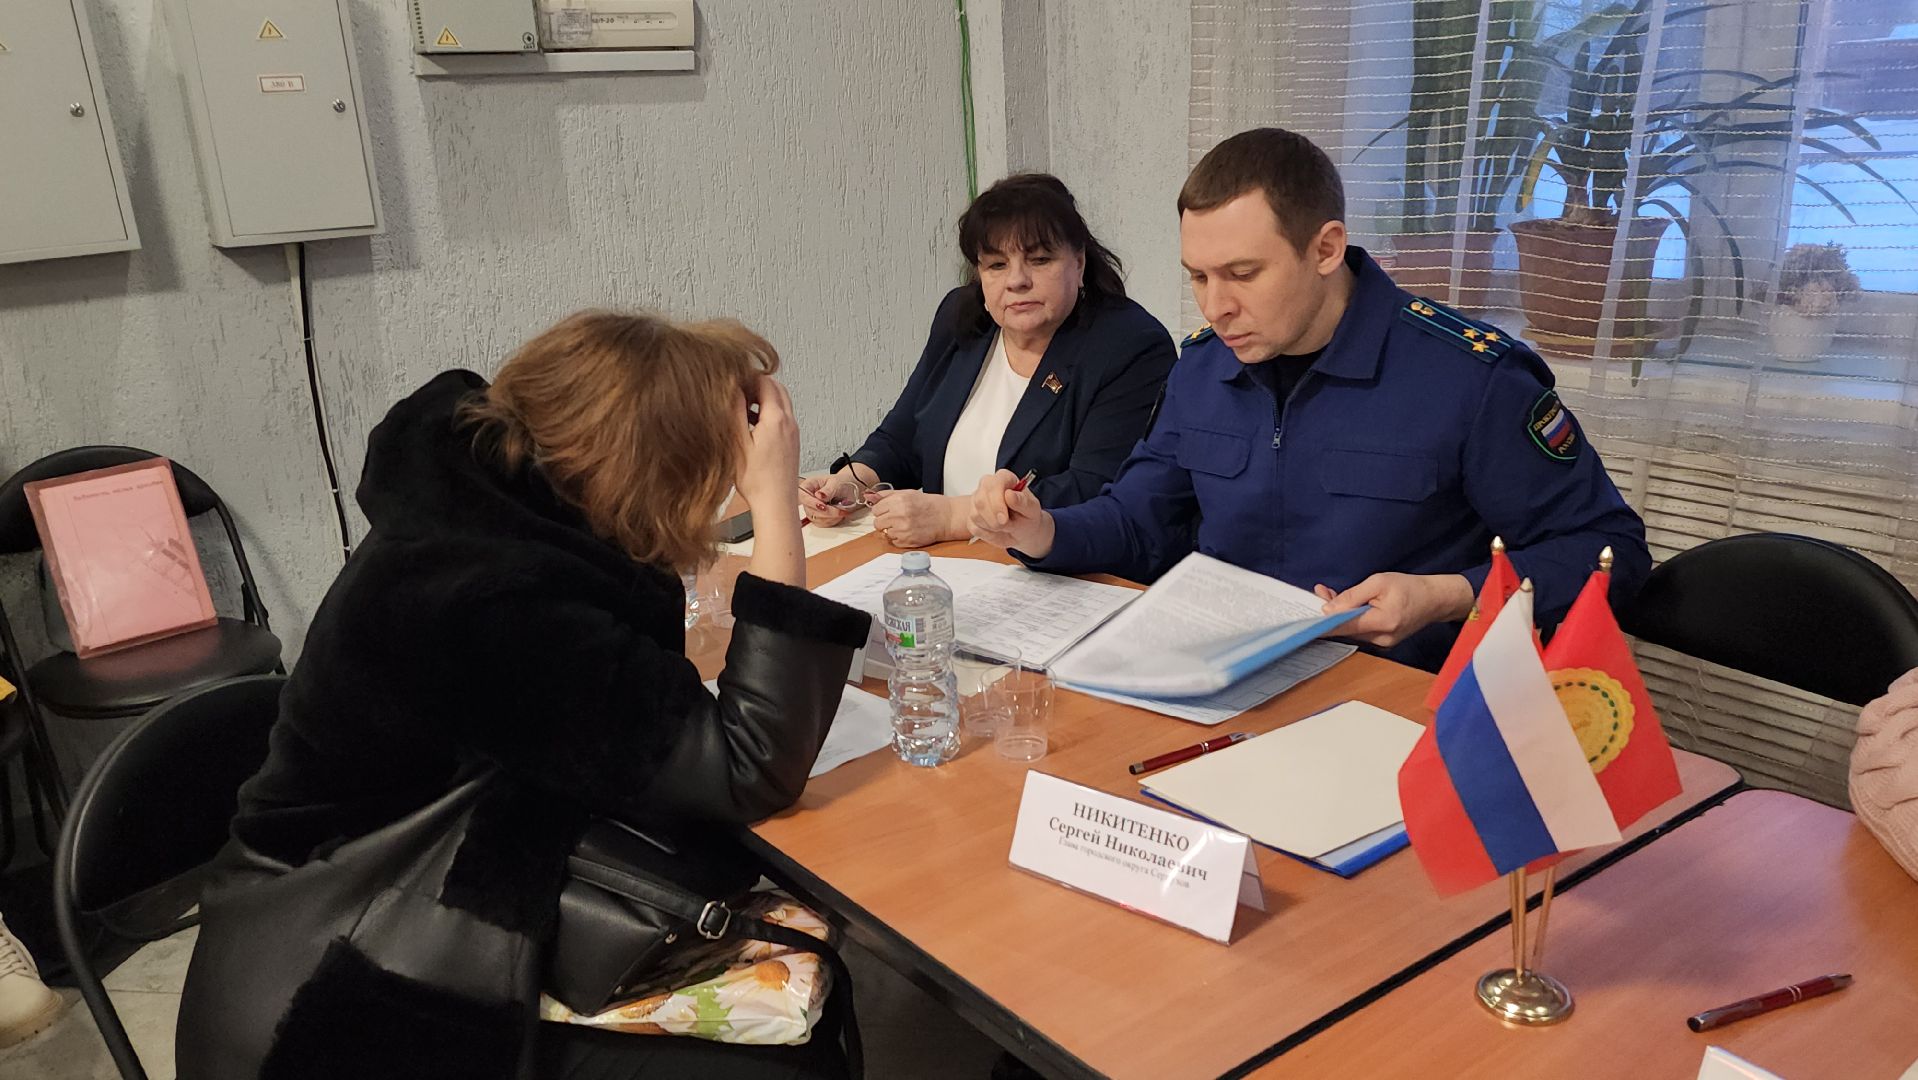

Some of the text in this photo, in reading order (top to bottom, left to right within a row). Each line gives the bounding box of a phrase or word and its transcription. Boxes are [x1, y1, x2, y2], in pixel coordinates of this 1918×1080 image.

[1049, 816, 1100, 845] Сергей
[1073, 802, 1190, 852] НИКИТЕНКО
[1150, 865, 1190, 888] Серхов
